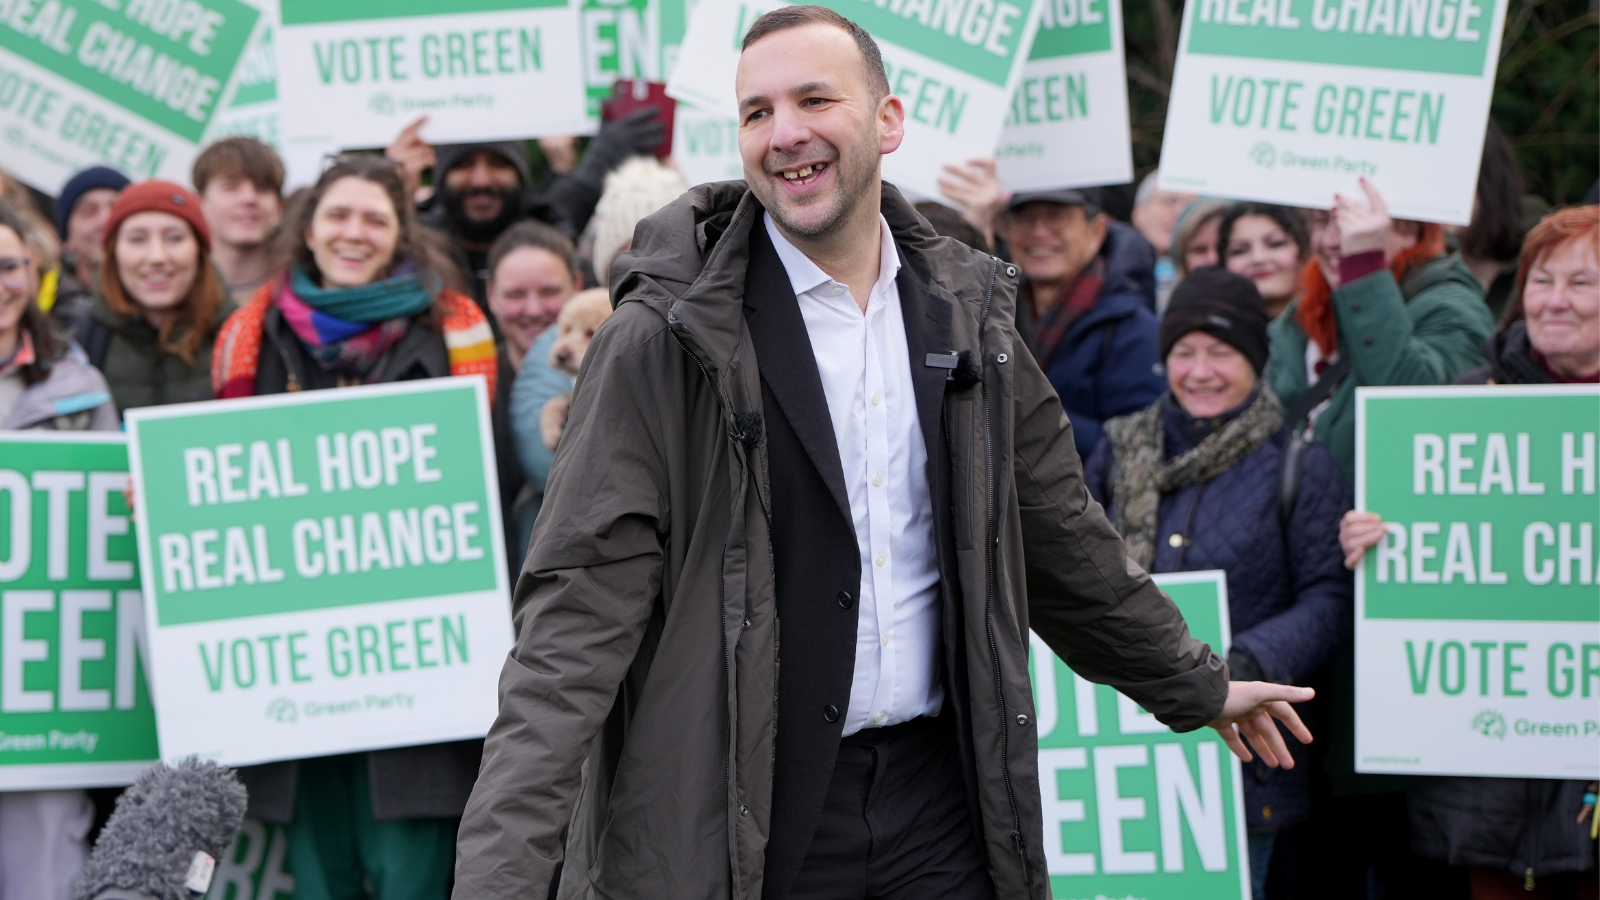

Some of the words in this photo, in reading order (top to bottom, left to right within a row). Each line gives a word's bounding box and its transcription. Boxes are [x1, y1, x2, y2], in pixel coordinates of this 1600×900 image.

[77, 20, 221, 123] CHANGE
[313, 37, 407, 85] VOTE
[420, 26, 544, 79] GREEN
[1209, 74, 1304, 132] VOTE
[1312, 82, 1445, 145] GREEN
[1281, 150, 1330, 170] Green
[183, 438, 308, 506] REAL
[316, 423, 442, 493] HOPE
[1412, 432, 1545, 496] REAL
[158, 524, 285, 593] REAL
[292, 501, 484, 578] CHANGE
[1375, 521, 1508, 585] REAL
[1522, 520, 1600, 586] CH
[198, 631, 312, 693] VOTE
[326, 613, 470, 679] GREEN
[1404, 639, 1529, 698] VOTE
[304, 701, 362, 719] Green
[1514, 718, 1579, 737] Green
